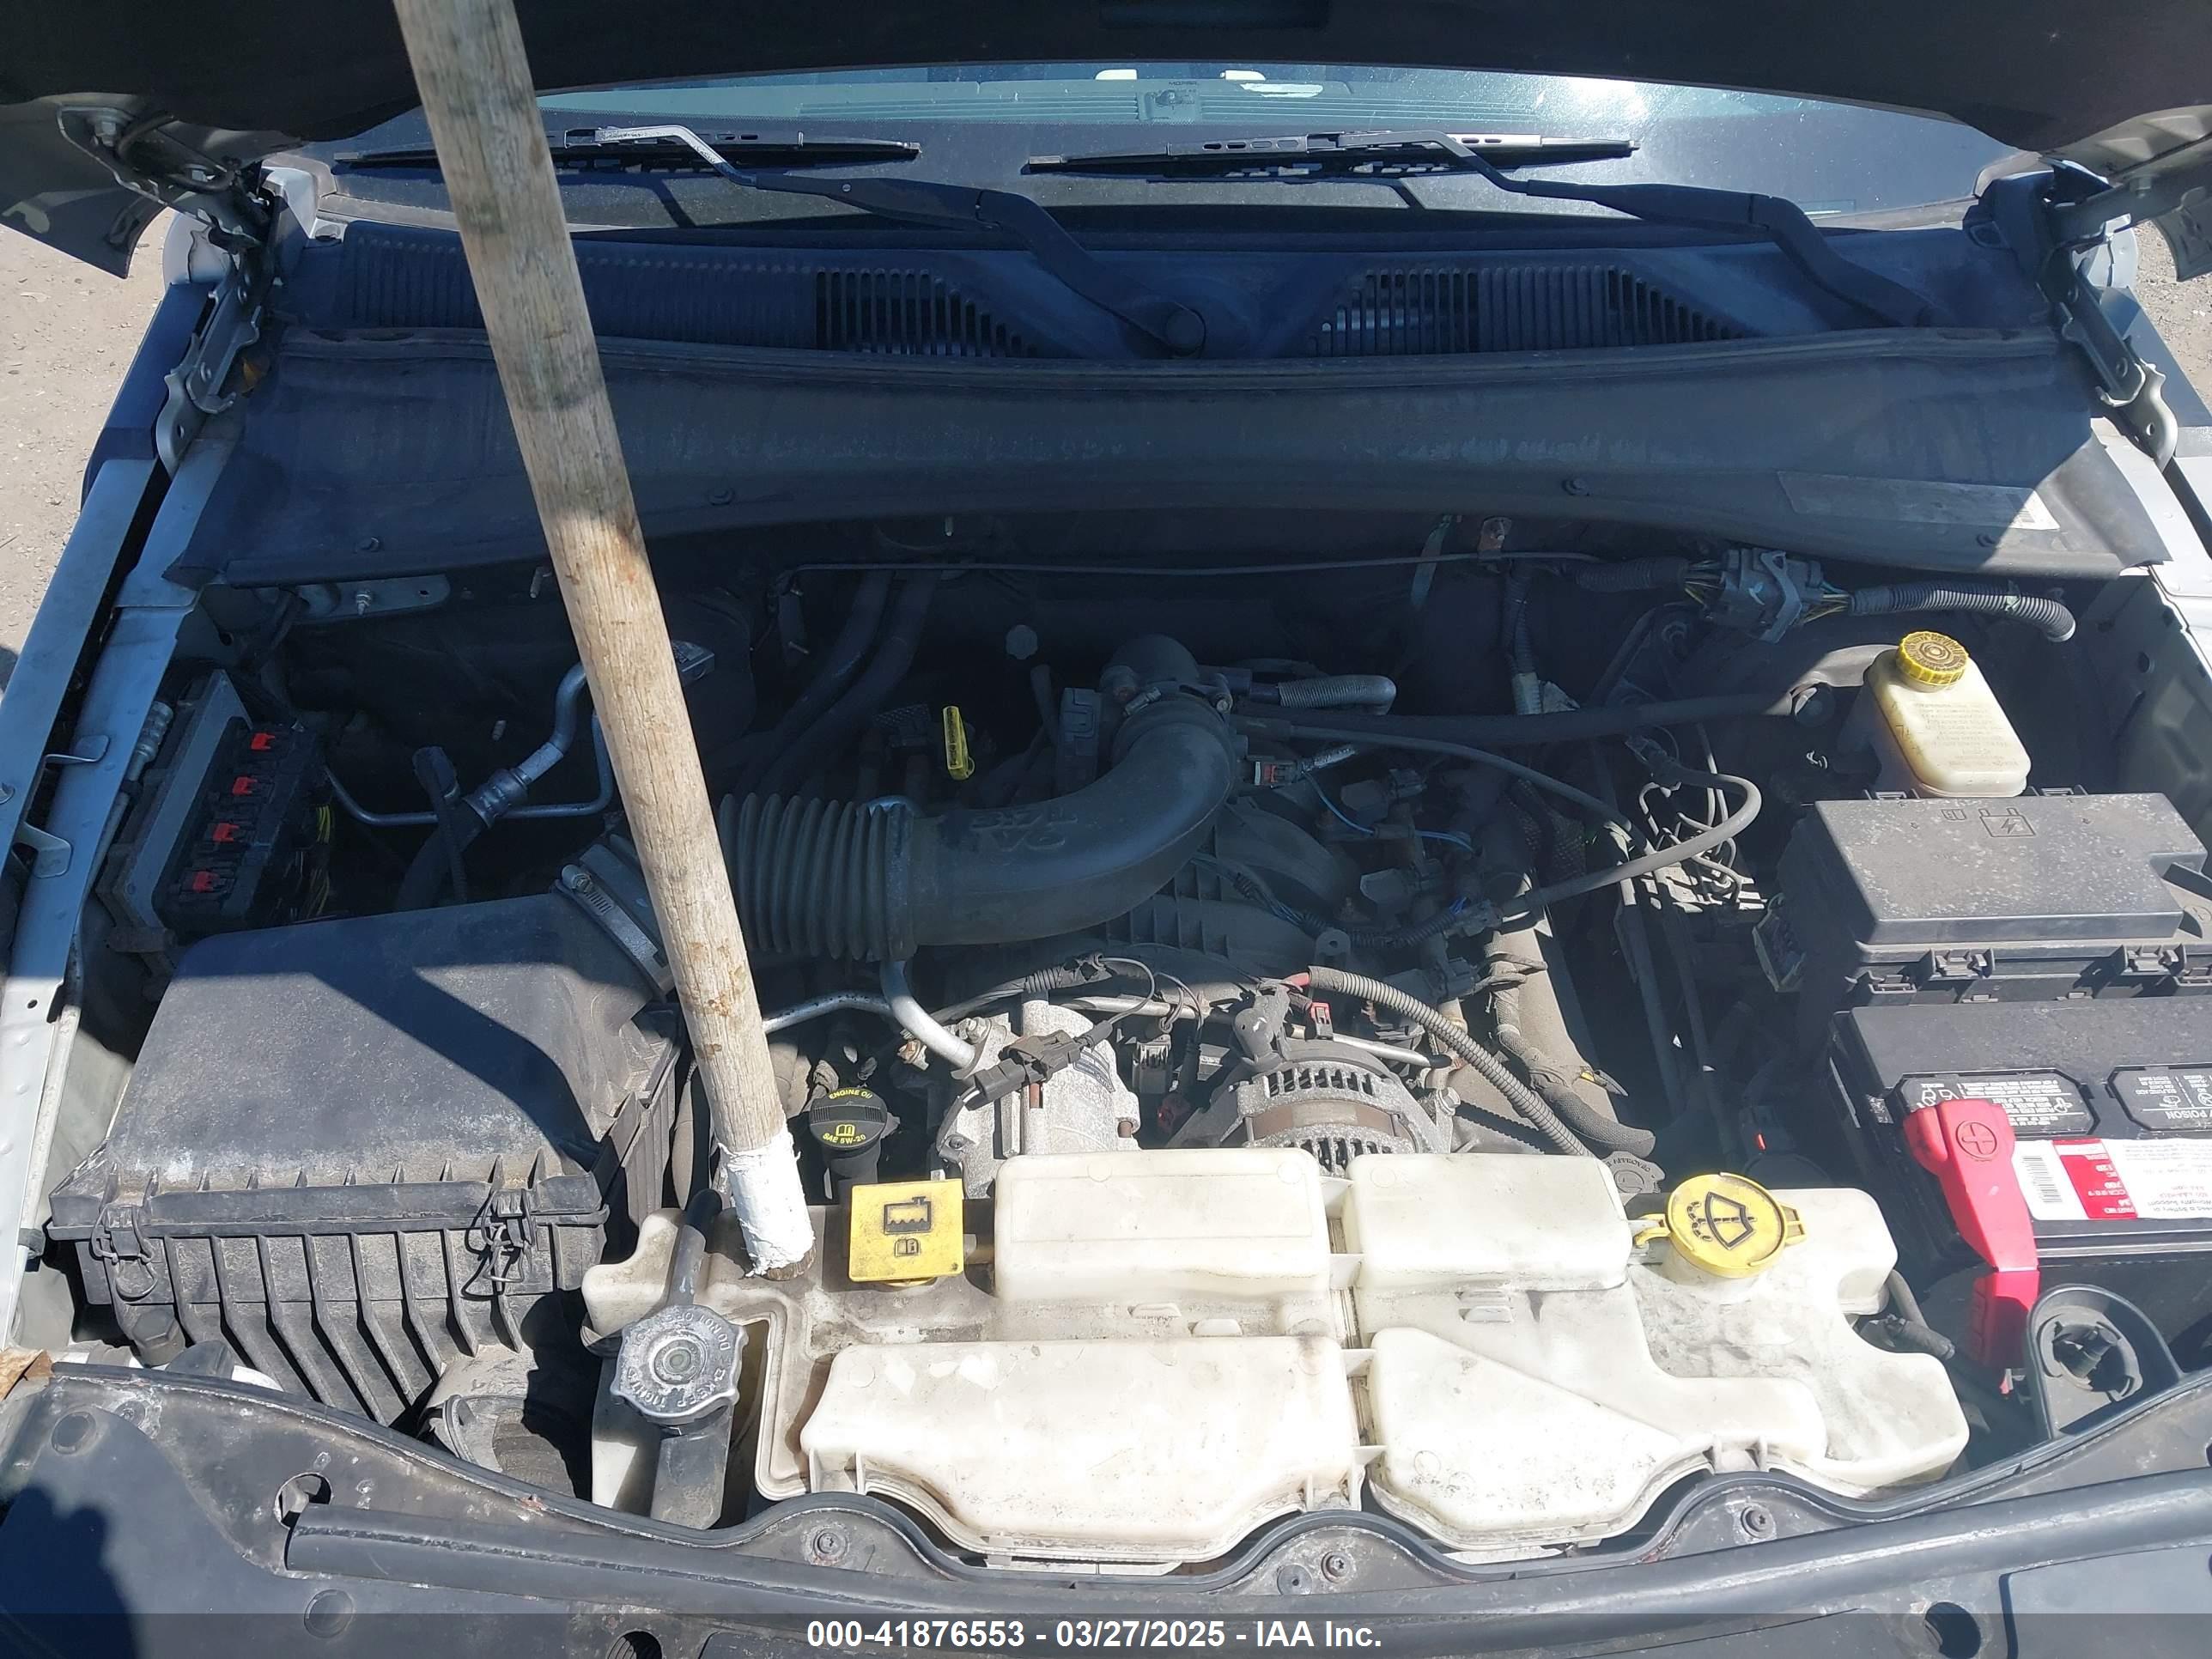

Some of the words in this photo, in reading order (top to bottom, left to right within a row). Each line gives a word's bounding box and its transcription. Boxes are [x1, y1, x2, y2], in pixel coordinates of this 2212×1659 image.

[829, 1089, 860, 1099] ENGINE
[2164, 1109, 2208, 1119] POISON
[823, 1133, 840, 1144] SAE
[840, 1133, 866, 1146] 5W-20
[698, 1314, 722, 1334] NOT
[676, 1382, 716, 1407] KEEP
